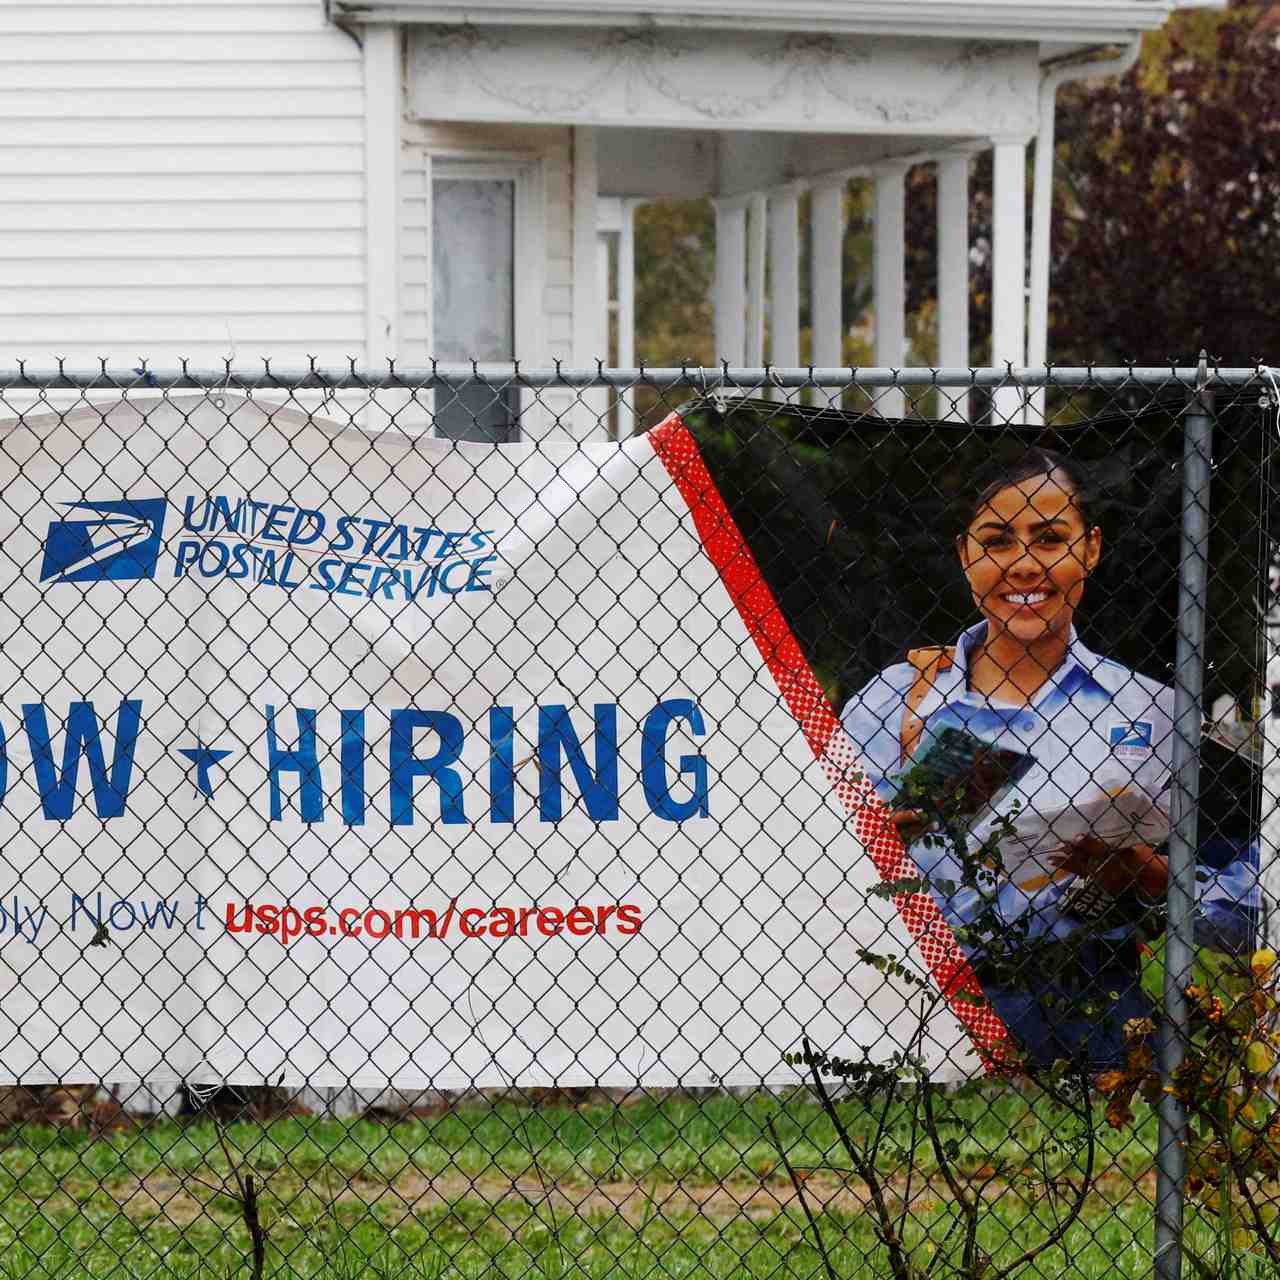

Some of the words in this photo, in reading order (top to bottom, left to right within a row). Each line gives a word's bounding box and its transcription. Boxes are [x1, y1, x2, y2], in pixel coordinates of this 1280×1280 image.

[184, 495, 326, 545] UNITED
[329, 516, 495, 561] STATES
[174, 540, 298, 588] POSTAL
[309, 555, 498, 601] SERVICE
[265, 698, 709, 826] HIRING
[72, 892, 179, 931] Now
[225, 896, 643, 945] usps.com/careers
